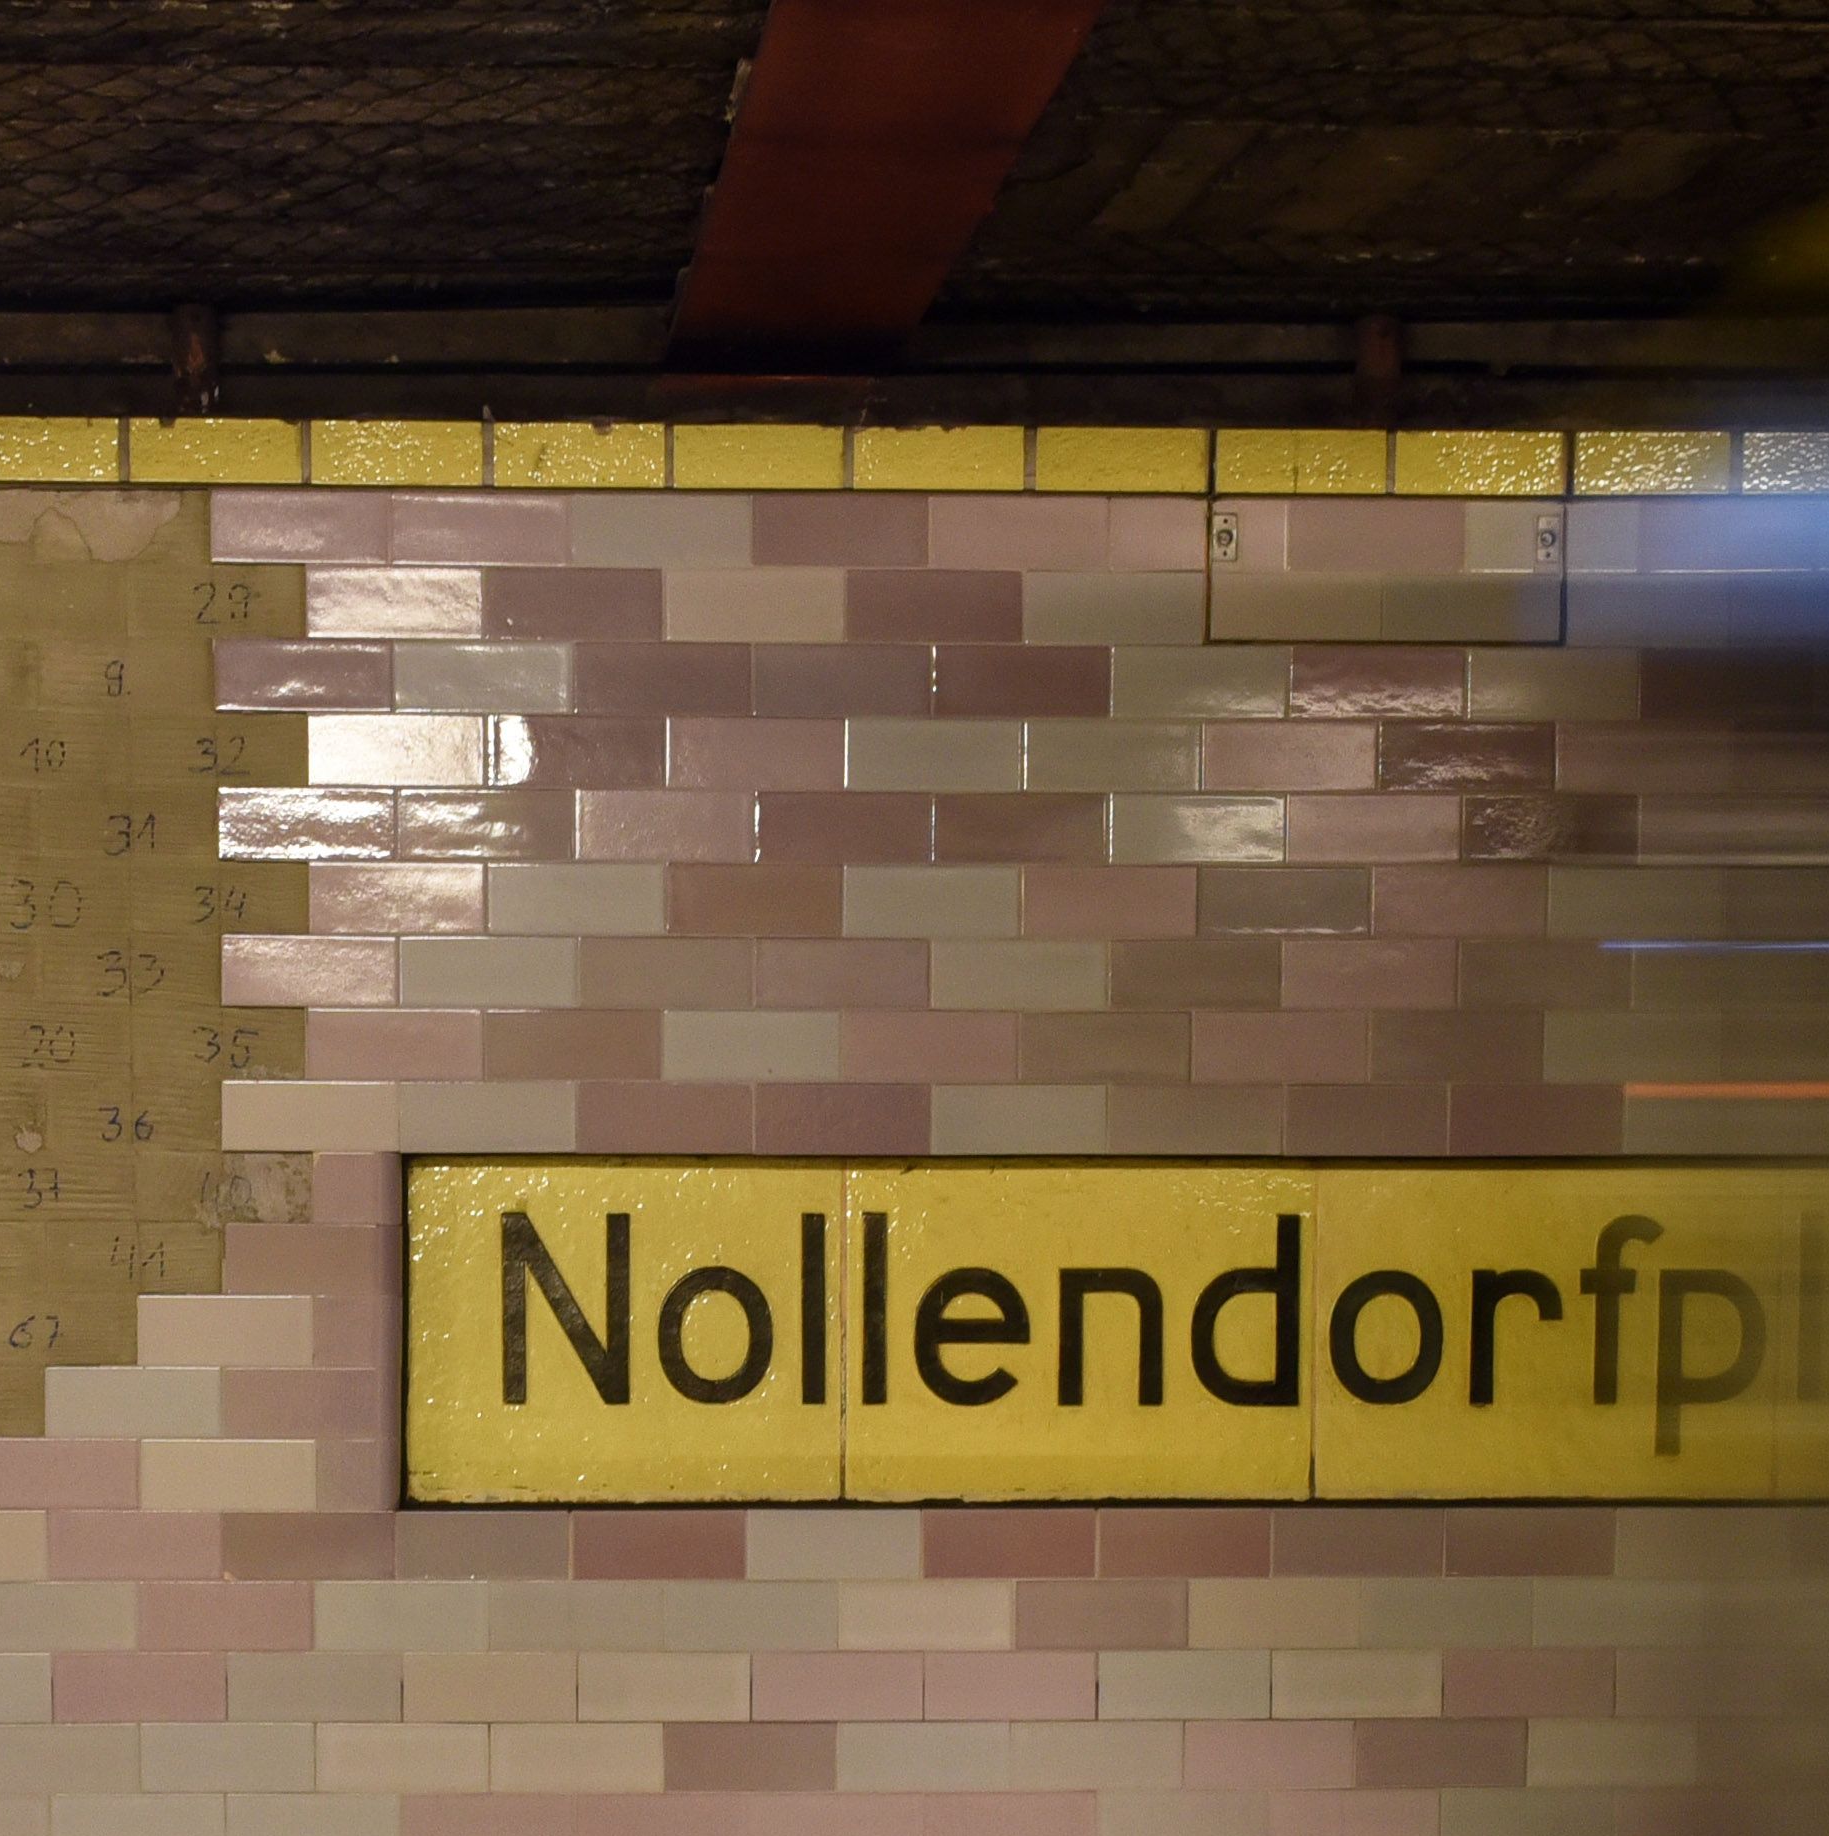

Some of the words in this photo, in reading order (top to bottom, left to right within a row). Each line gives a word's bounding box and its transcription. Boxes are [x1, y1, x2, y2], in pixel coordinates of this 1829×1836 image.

[20, 737, 66, 773] 10
[188, 736, 251, 776] 32
[104, 813, 156, 857] 31
[10, 879, 83, 930] 30
[194, 885, 247, 924] 34
[96, 949, 165, 998] 33
[22, 1024, 76, 1069] 20
[193, 1026, 260, 1069] 35
[98, 1105, 155, 1142] 36
[18, 1167, 59, 1209] 37
[109, 1236, 166, 1279] 41
[8, 1315, 61, 1349] 67
